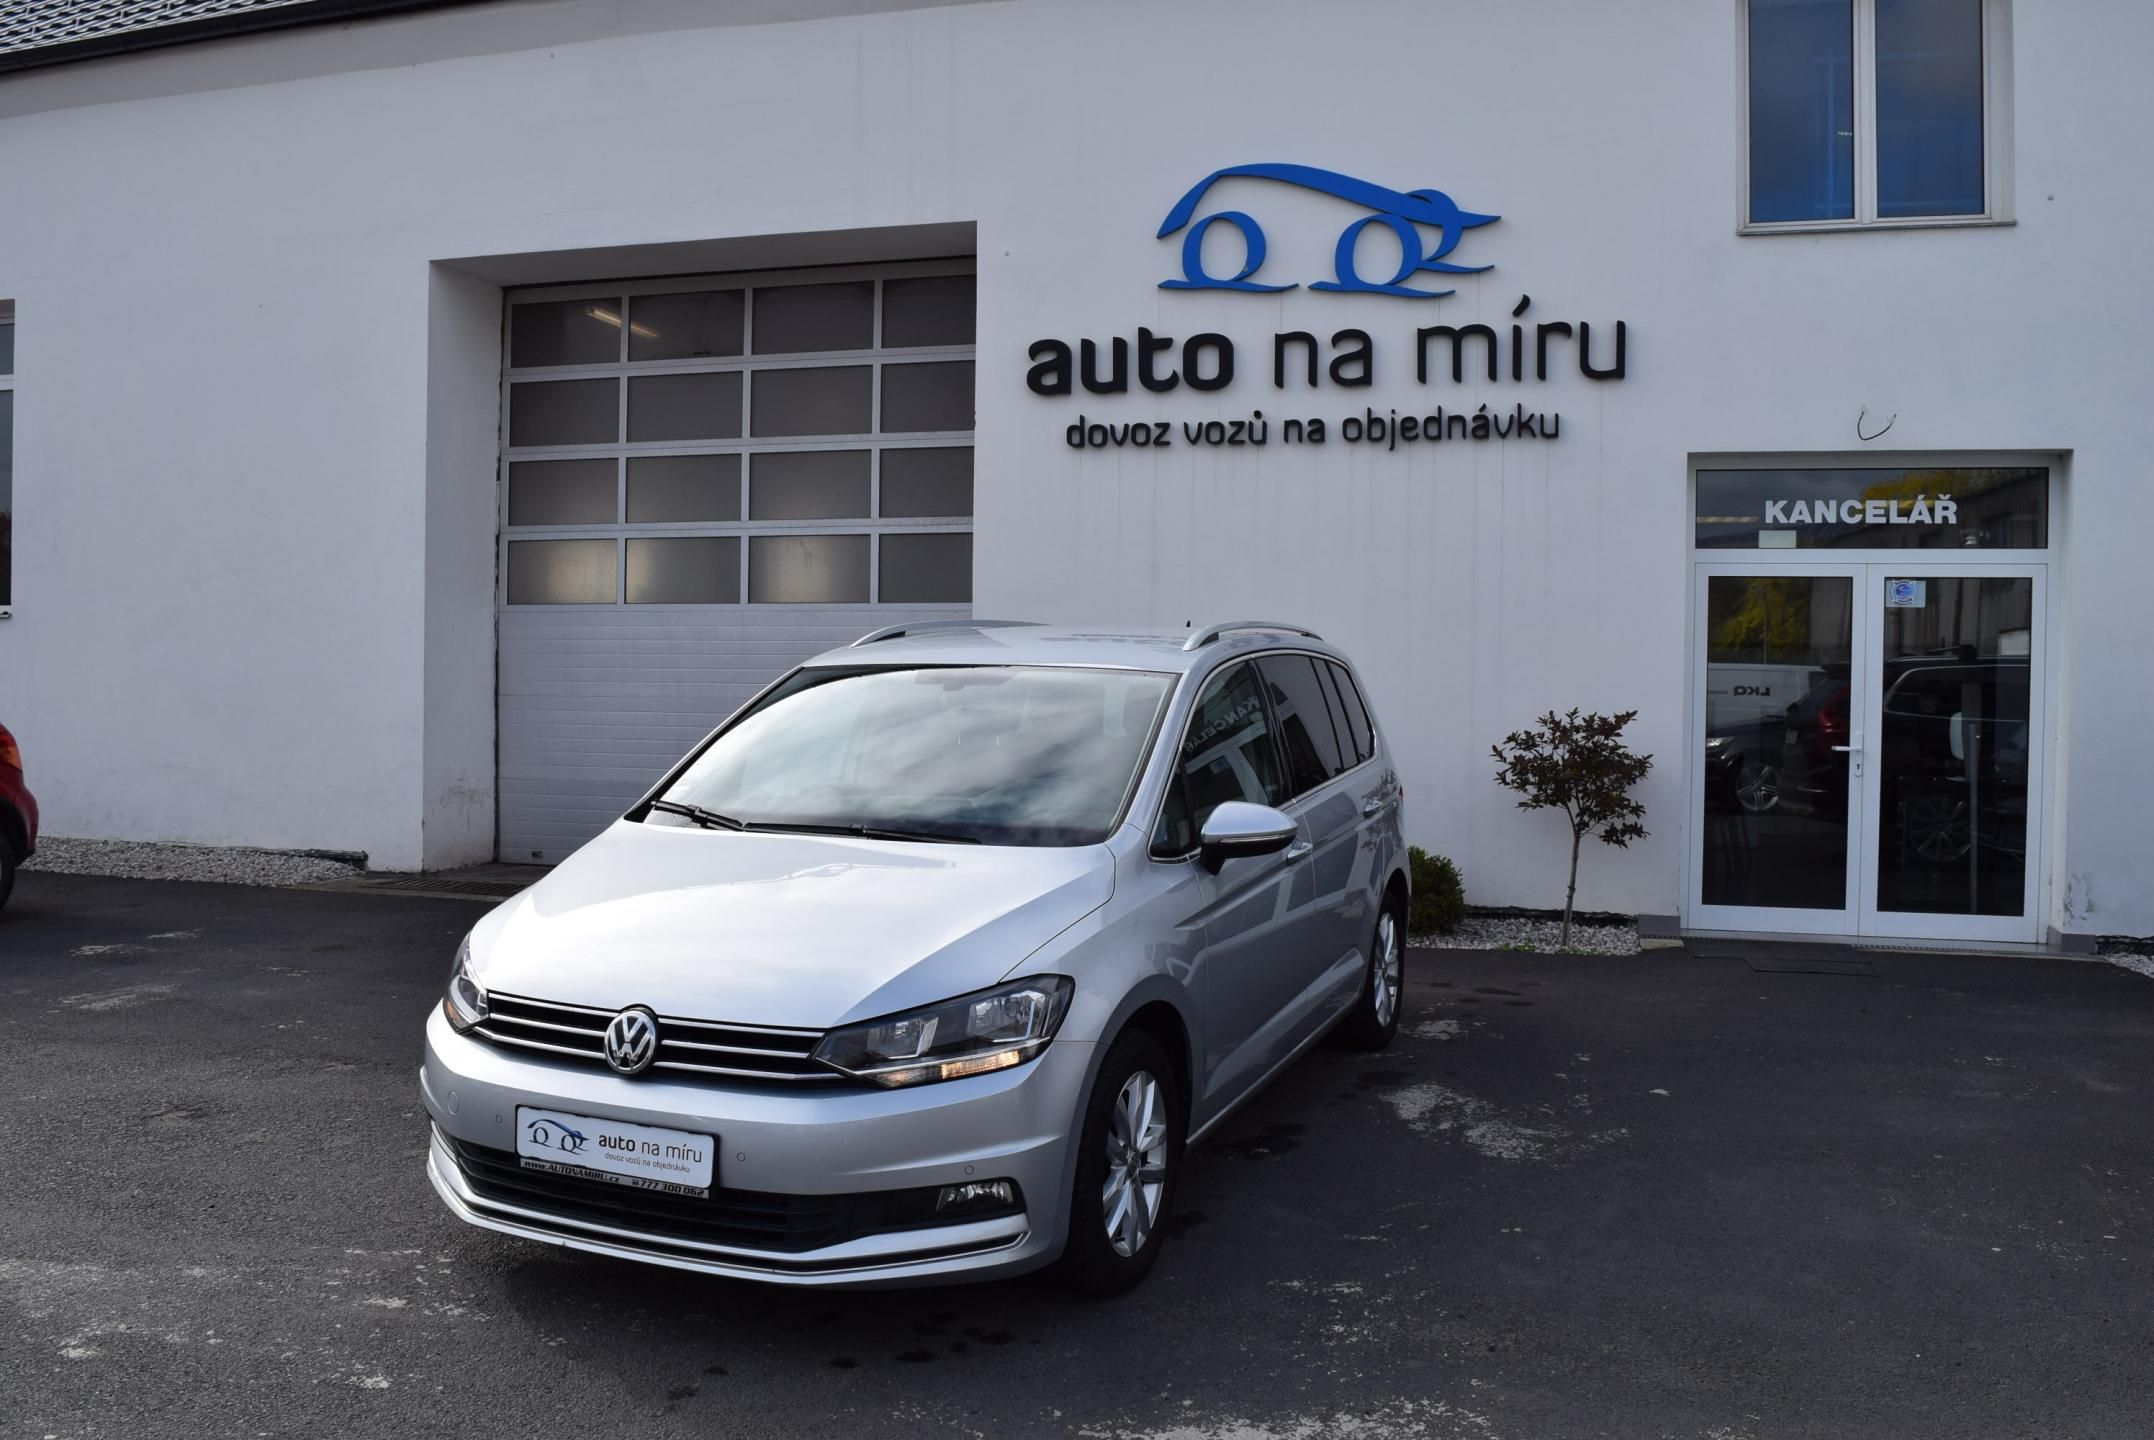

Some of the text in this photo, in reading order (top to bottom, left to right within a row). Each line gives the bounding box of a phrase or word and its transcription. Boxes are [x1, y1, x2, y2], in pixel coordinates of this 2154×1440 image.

[1026, 294, 1626, 396] auto na míru
[1066, 402, 1560, 451] dovoz vozů na objednávku
[1765, 494, 1958, 524] KANCELÁŘ
[598, 1134, 703, 1163] auto na míru
[604, 1151, 625, 1163] dovoz
[642, 1159, 652, 1168] na
[652, 1160, 691, 1174] objednávku
[640, 1180, 659, 1190] 777
